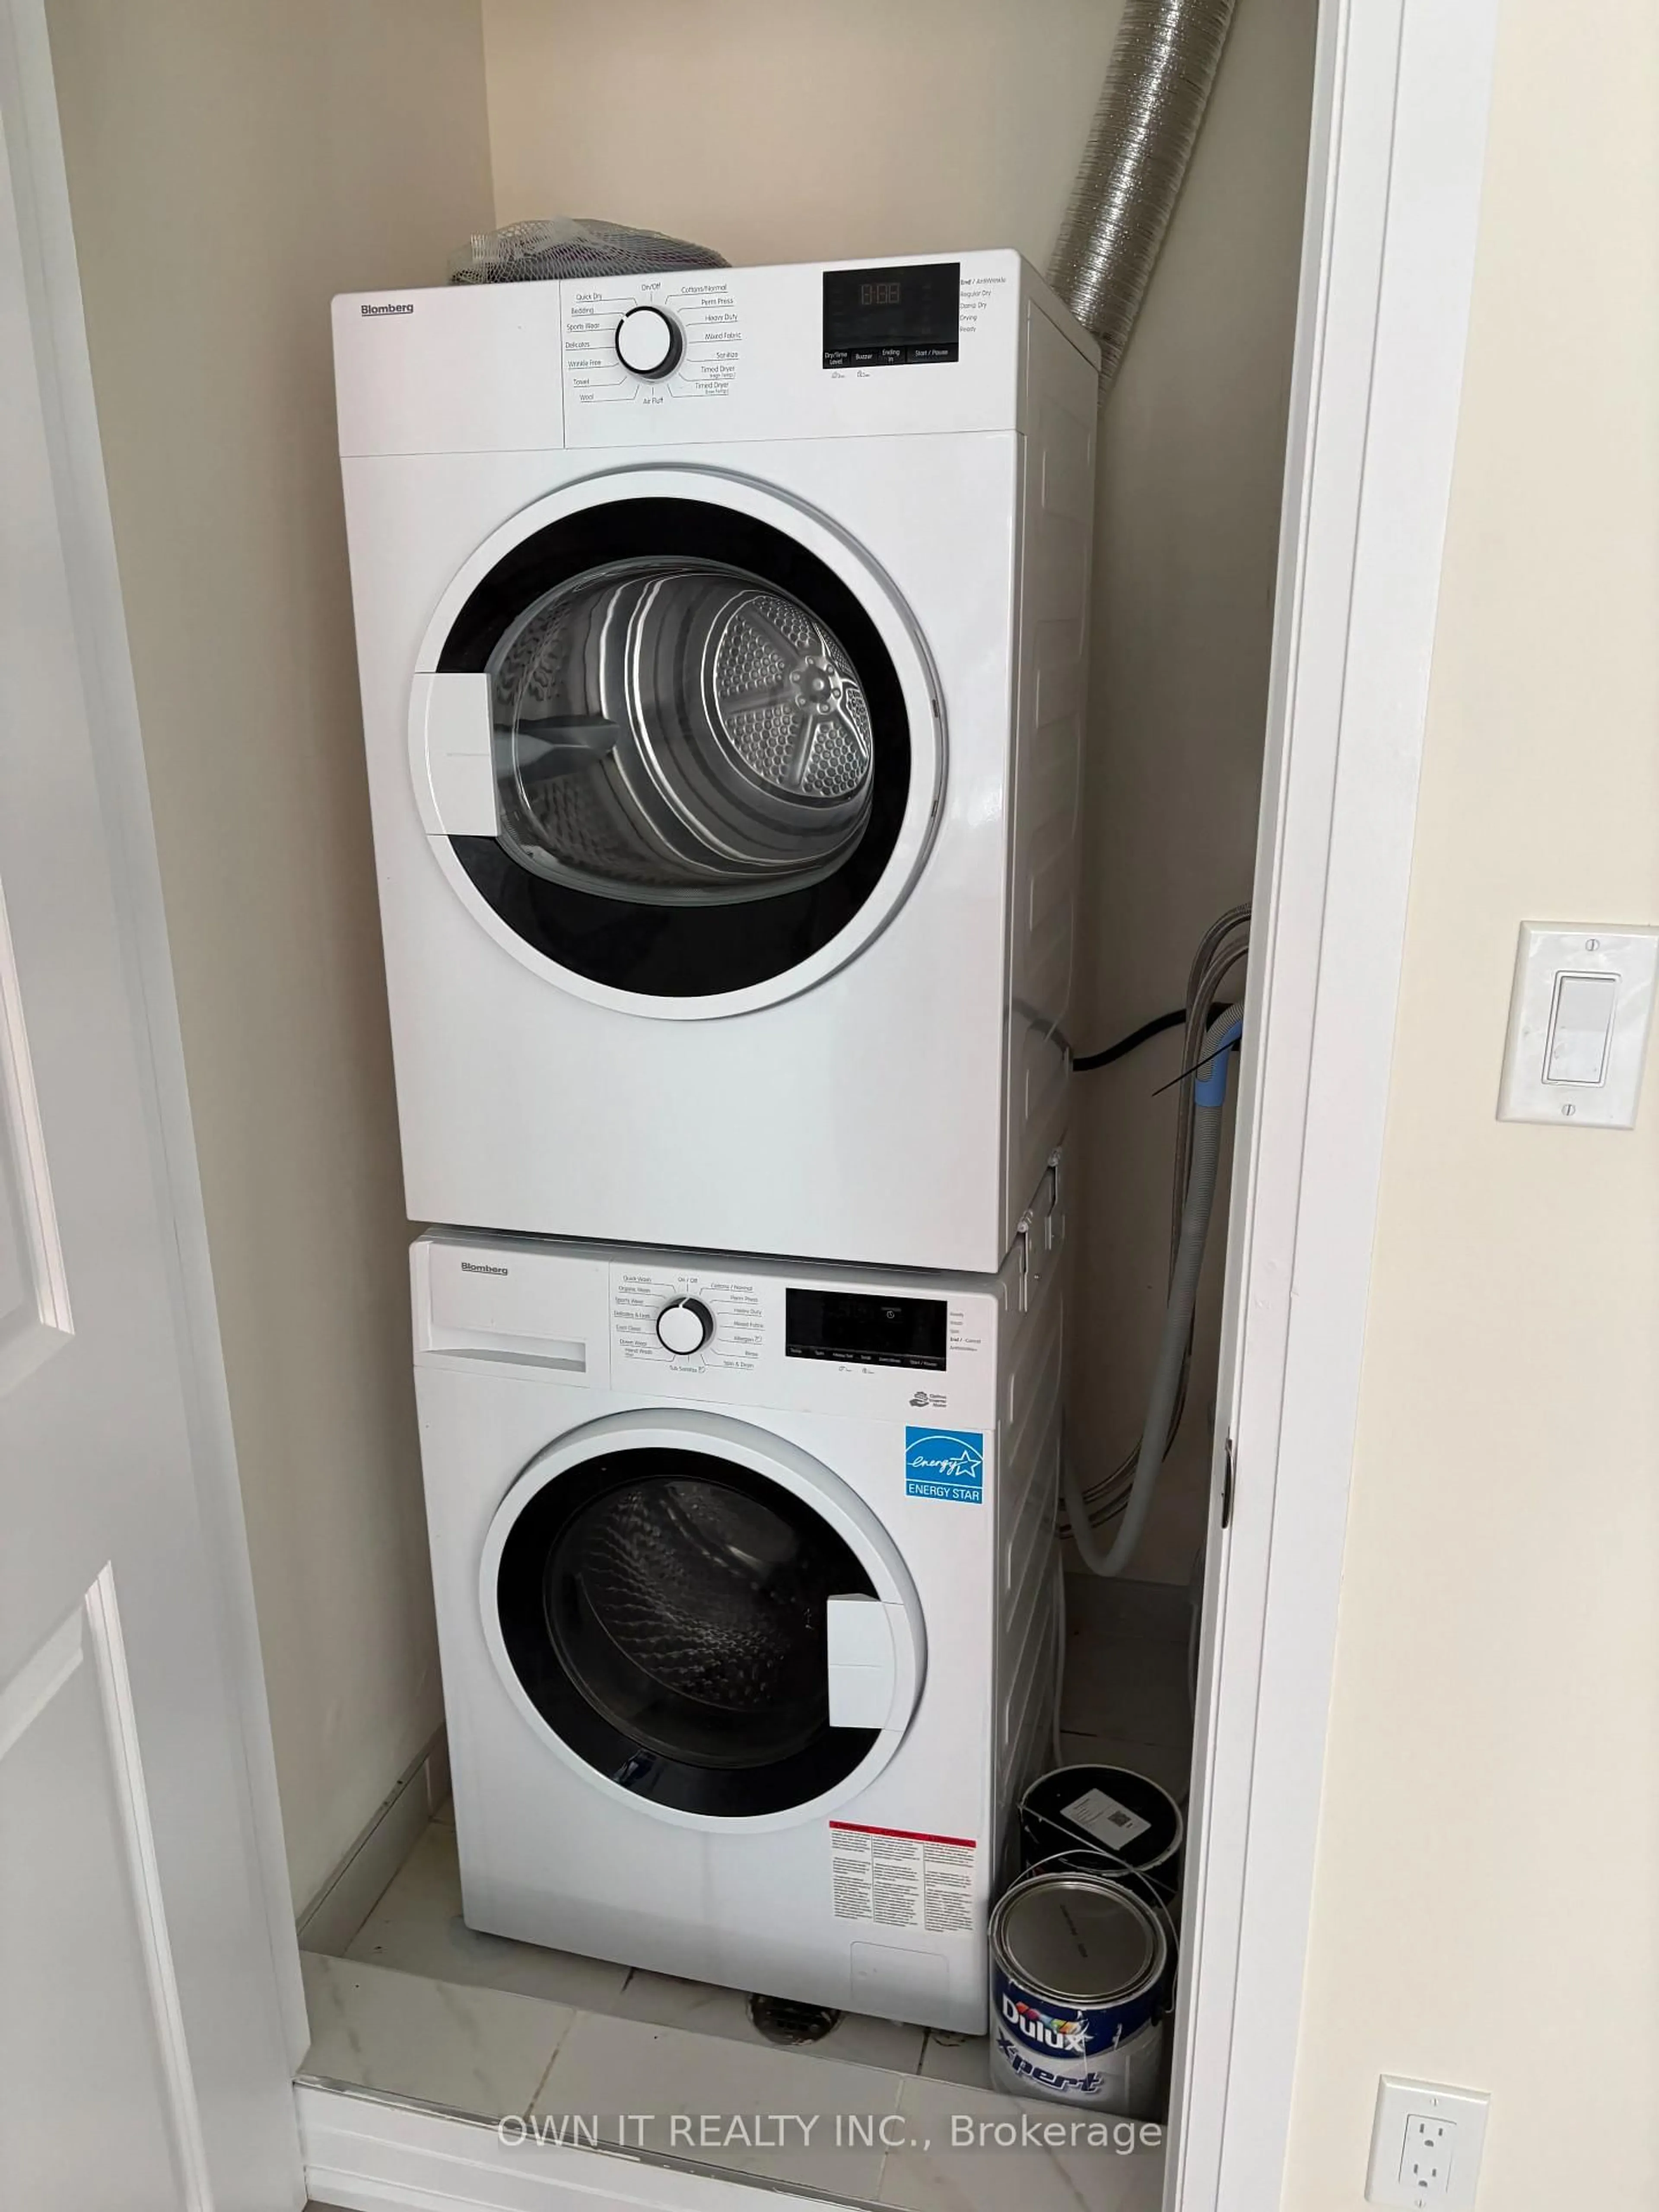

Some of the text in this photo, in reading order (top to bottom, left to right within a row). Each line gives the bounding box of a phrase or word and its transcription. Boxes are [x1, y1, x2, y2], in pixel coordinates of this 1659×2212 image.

[681, 285, 727, 293] Cottons/Normal
[361, 304, 413, 316] Blomberg
[461, 1262, 508, 1275] Blomberg
[912, 1456, 958, 1475] energy
[909, 1484, 979, 1501] ENERGY STAR
[1002, 1992, 1084, 2052] Dulux
